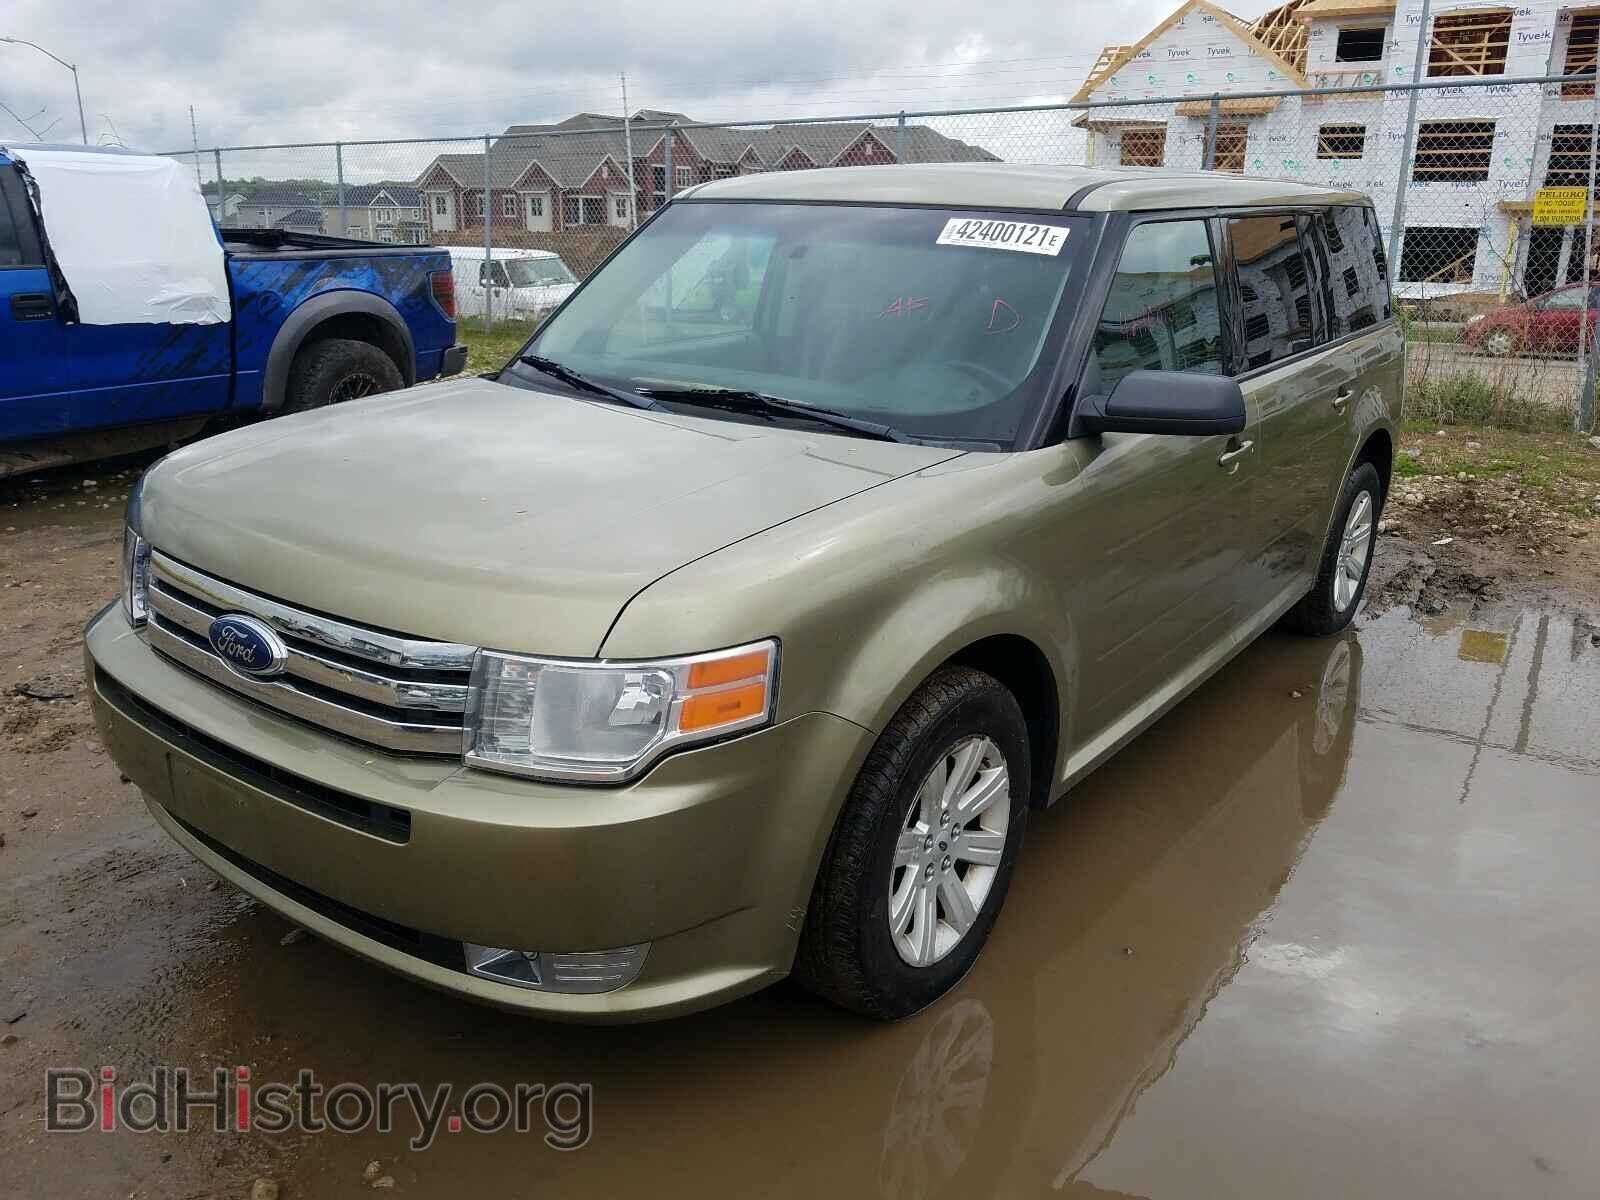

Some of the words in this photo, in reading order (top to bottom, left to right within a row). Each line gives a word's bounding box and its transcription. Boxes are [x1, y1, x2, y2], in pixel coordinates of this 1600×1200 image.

[1167, 48, 1190, 57] Tyvek
[1207, 47, 1231, 56] Tyvek
[1437, 86, 1464, 95] Tyvek
[1486, 83, 1514, 94] Tyvek
[1539, 191, 1585, 199] PELIGRO
[956, 220, 1051, 247] 42400121
[1048, 235, 1061, 247] E
[217, 626, 257, 663] Ford
